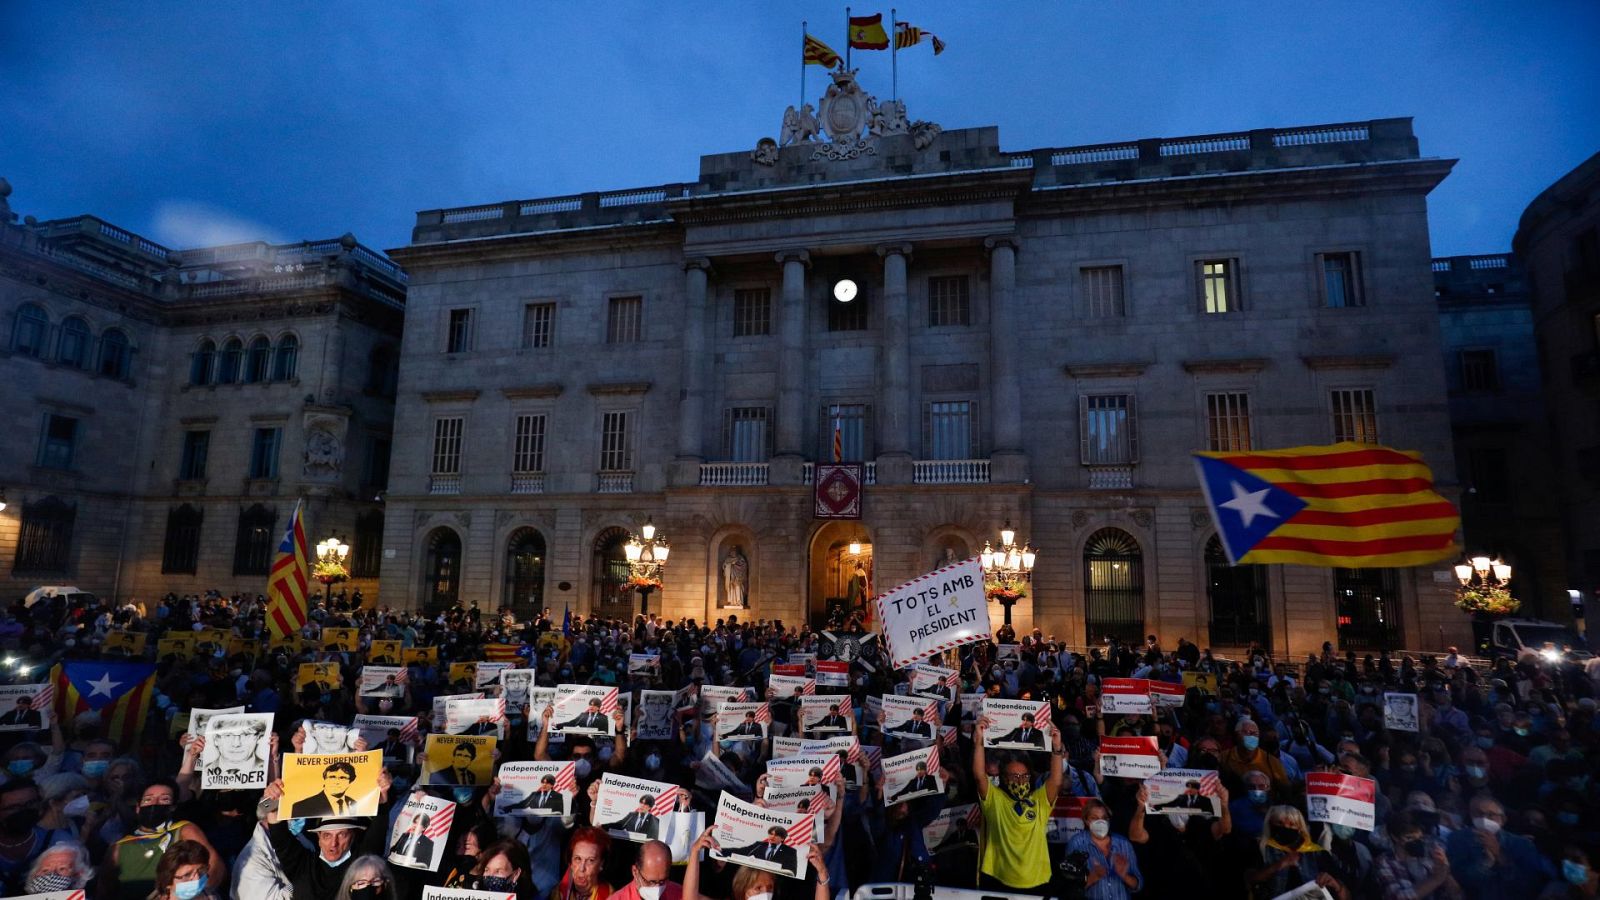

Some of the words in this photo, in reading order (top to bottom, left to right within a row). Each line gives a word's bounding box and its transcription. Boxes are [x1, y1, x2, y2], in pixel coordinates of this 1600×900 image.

[892, 587, 938, 614] TOTS
[943, 575, 974, 596] AMB
[927, 604, 942, 617] EL
[910, 608, 976, 643] PRESIDENT
[987, 702, 1037, 711] Independència
[297, 756, 321, 766] NEVER
[323, 755, 369, 766] SURRENDER
[771, 758, 825, 766] Independència
[207, 766, 222, 777] NO
[605, 777, 661, 794] Independència
[768, 790, 816, 800] Independència
[723, 798, 793, 826] Independència
[721, 812, 763, 830] #FreePresident
